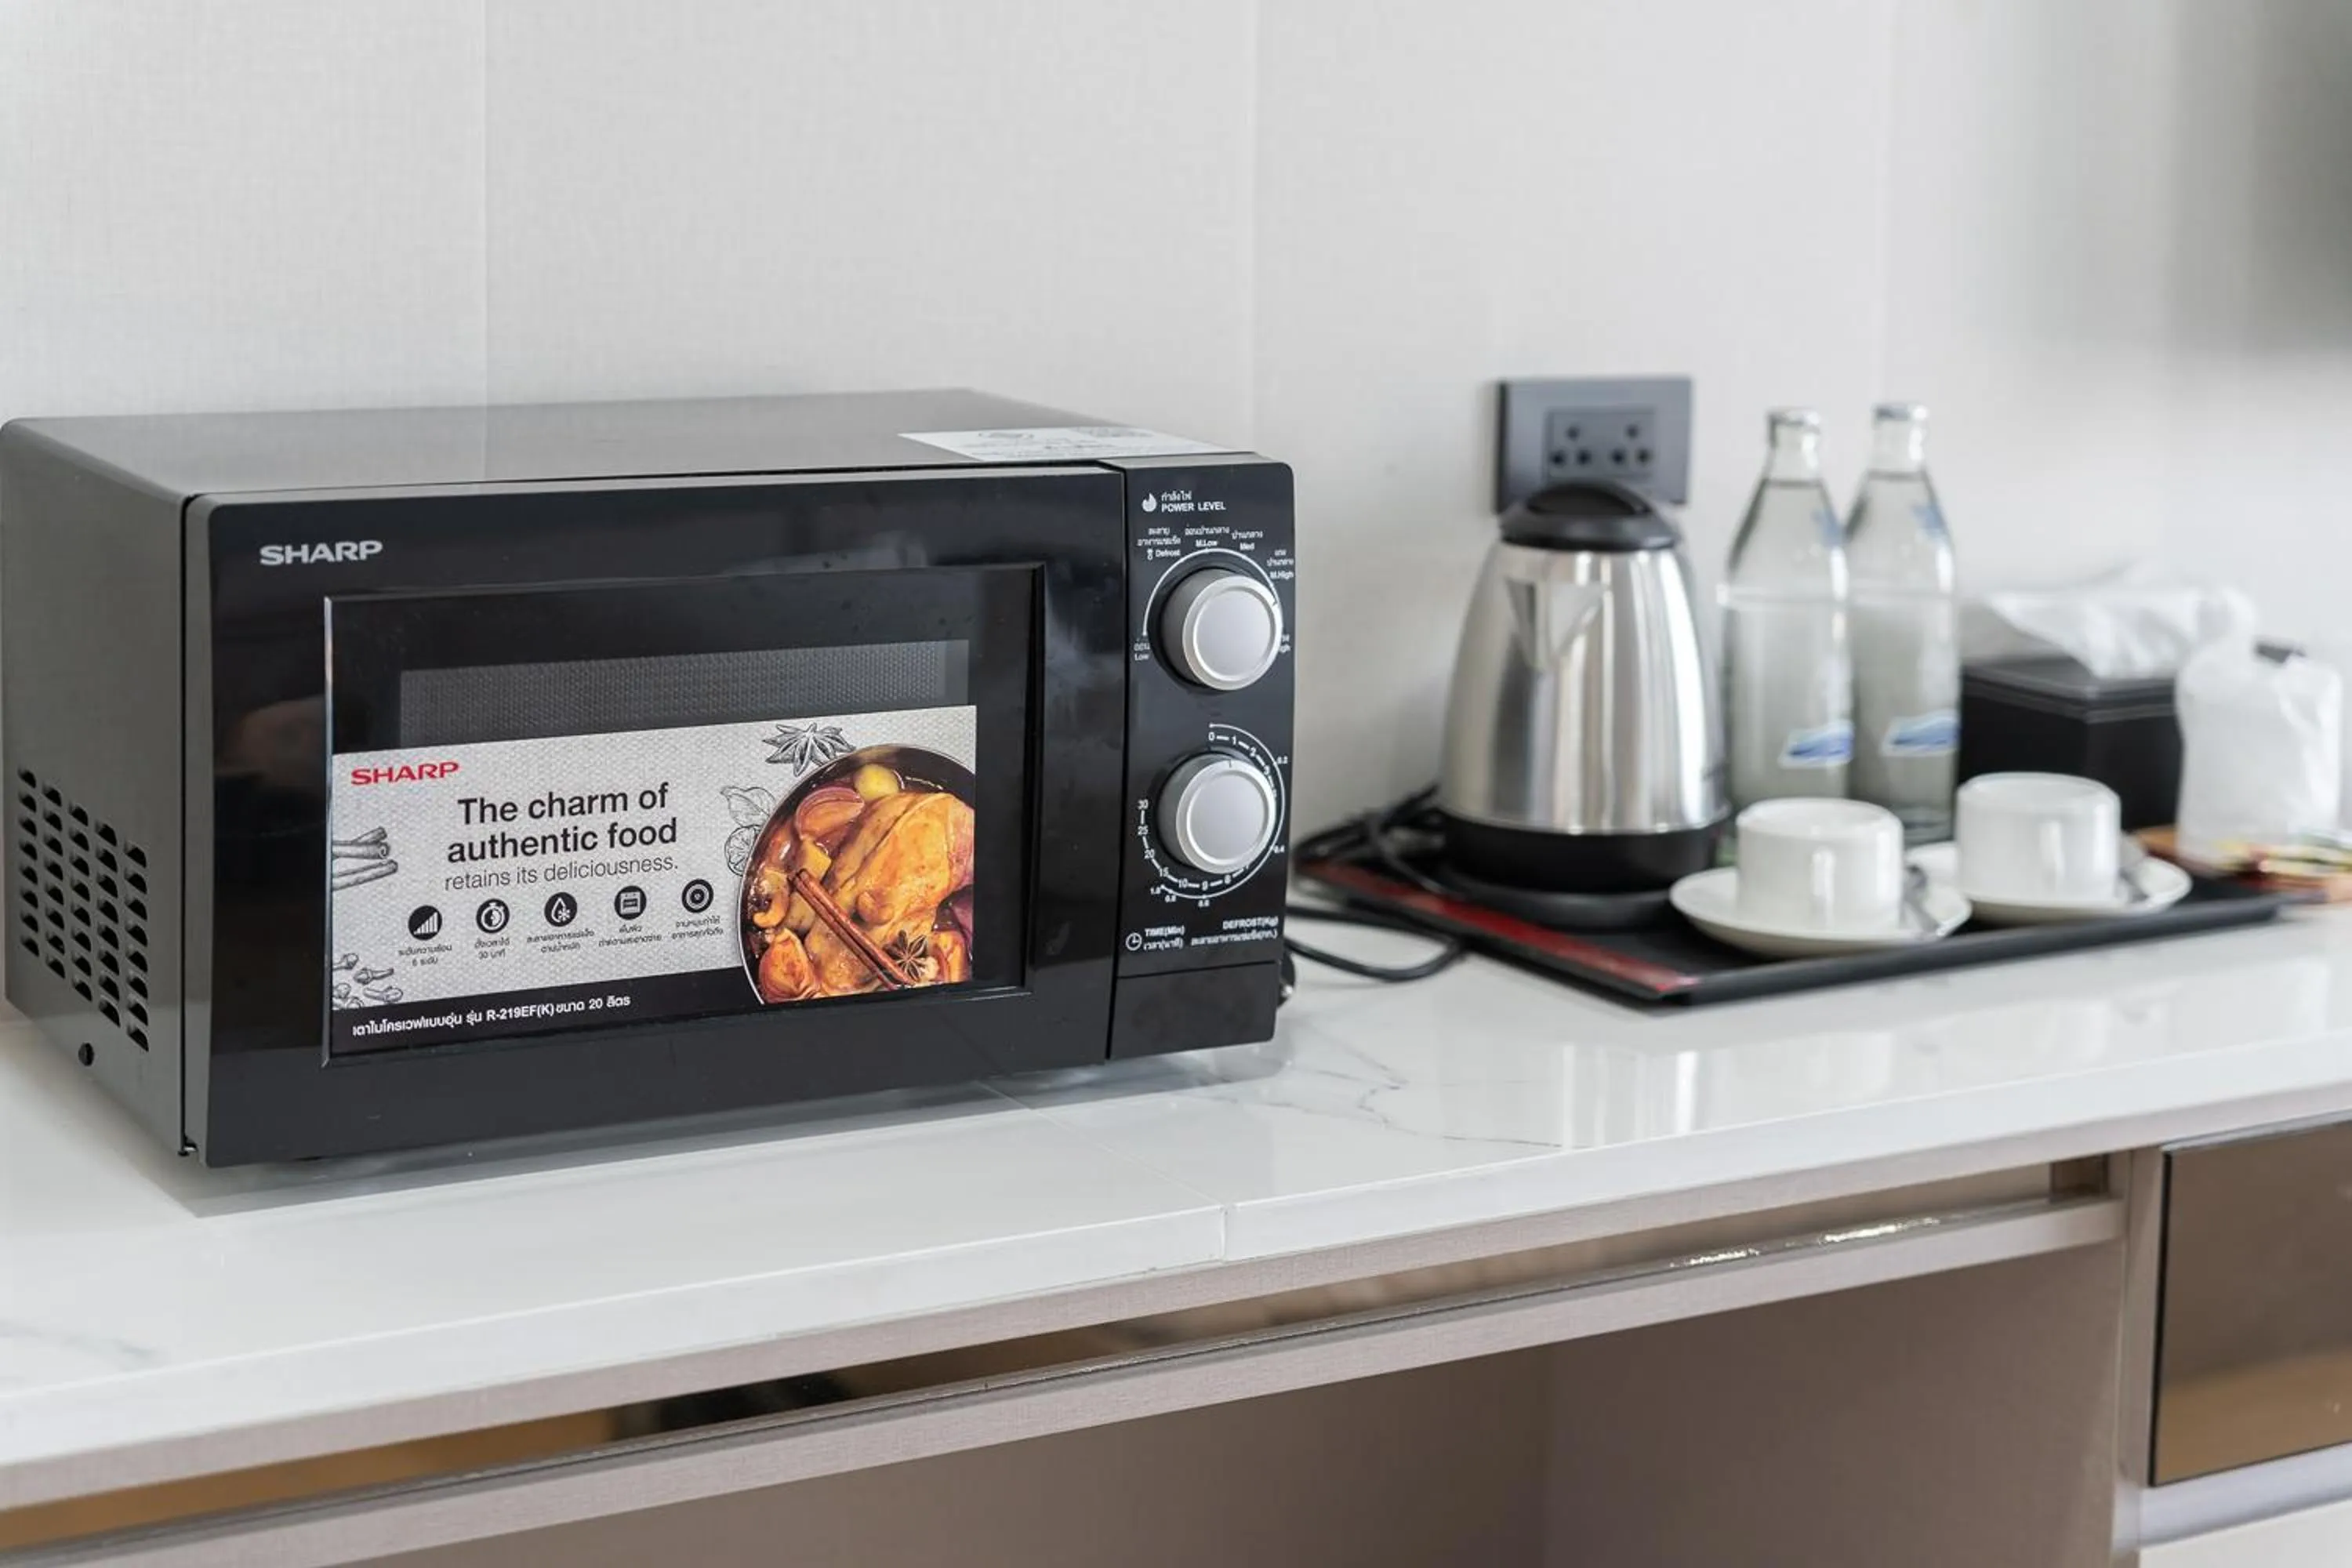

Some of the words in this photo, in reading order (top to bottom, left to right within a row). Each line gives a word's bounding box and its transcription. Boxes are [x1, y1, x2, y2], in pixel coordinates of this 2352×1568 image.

[1161, 503, 1195, 513] POWER
[1197, 501, 1226, 510] LEVEL
[260, 539, 383, 565] SHARP
[1208, 732, 1215, 741] 0
[1232, 735, 1236, 745] 1
[1250, 746, 1257, 757] 2
[351, 761, 459, 786] SHARP
[1263, 765, 1270, 775] 3
[458, 796, 518, 826] The
[528, 789, 628, 818] charm
[639, 782, 670, 811] of
[1138, 799, 1149, 811] 30
[1138, 826, 1149, 836] 25
[448, 826, 598, 863] authentic
[608, 817, 677, 848] food
[1144, 848, 1155, 859] 20
[445, 870, 510, 891] retains
[517, 866, 538, 883] its
[543, 855, 679, 881] deliciousness.
[1159, 866, 1169, 877] 15
[1178, 878, 1188, 888] 10
[352, 1013, 463, 1037] เตาไมโครเวฟแบบอุ่น
[466, 1011, 482, 1027] รุ่น
[486, 1003, 555, 1022] R-219EF(K)
[556, 1001, 585, 1014] ขนาด
[589, 999, 604, 1010] 20
[607, 996, 631, 1008] ลิตร
